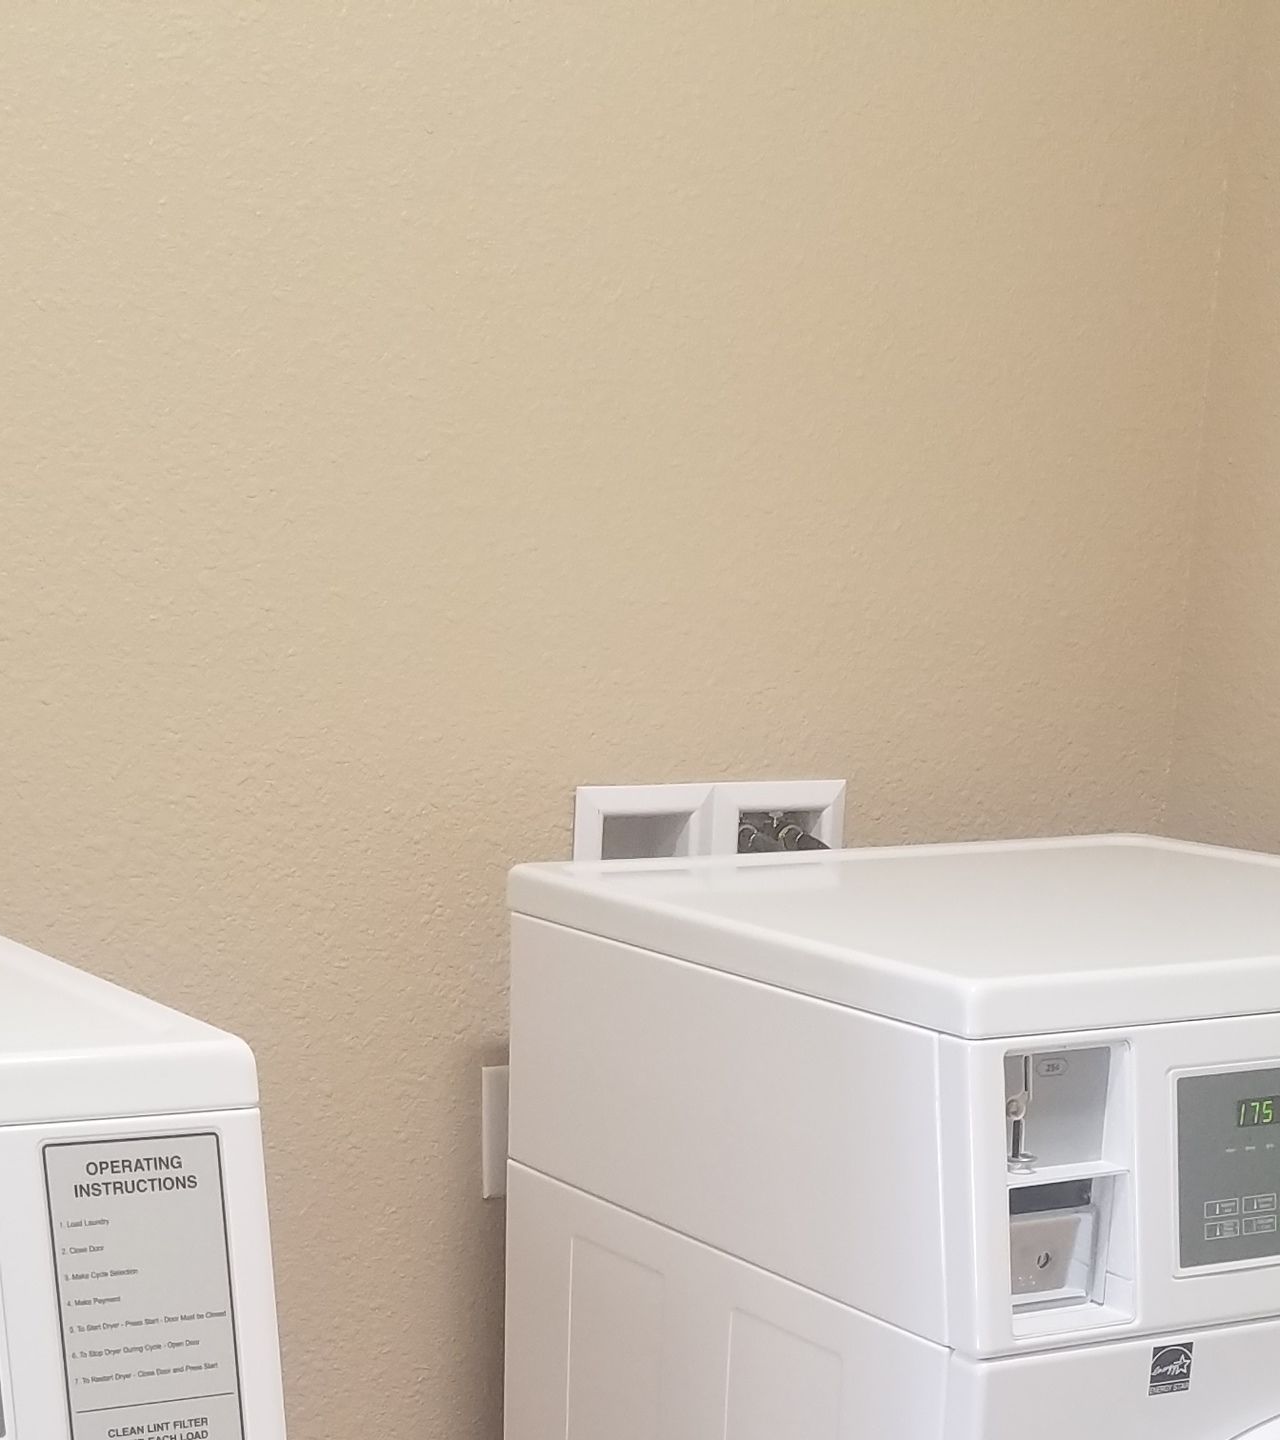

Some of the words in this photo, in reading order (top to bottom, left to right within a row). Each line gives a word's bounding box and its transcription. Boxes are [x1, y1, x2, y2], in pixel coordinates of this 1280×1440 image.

[1239, 1100, 1273, 1126] 175
[85, 1155, 183, 1176] OPERATING
[73, 1175, 198, 1198] INSTRUCTIONS
[66, 1220, 83, 1228] Load
[85, 1219, 110, 1227] Laundry
[91, 1271, 108, 1280] Cycle
[103, 1322, 119, 1330] Dryer
[105, 1348, 121, 1356] Dryer
[123, 1346, 144, 1354] During
[145, 1343, 162, 1352] Cycle
[168, 1341, 184, 1349] Open
[108, 1426, 145, 1438] CLEAN
[147, 1422, 170, 1433] LINT
[173, 1417, 209, 1429] FILTER
[181, 1430, 209, 1440] LOAD
